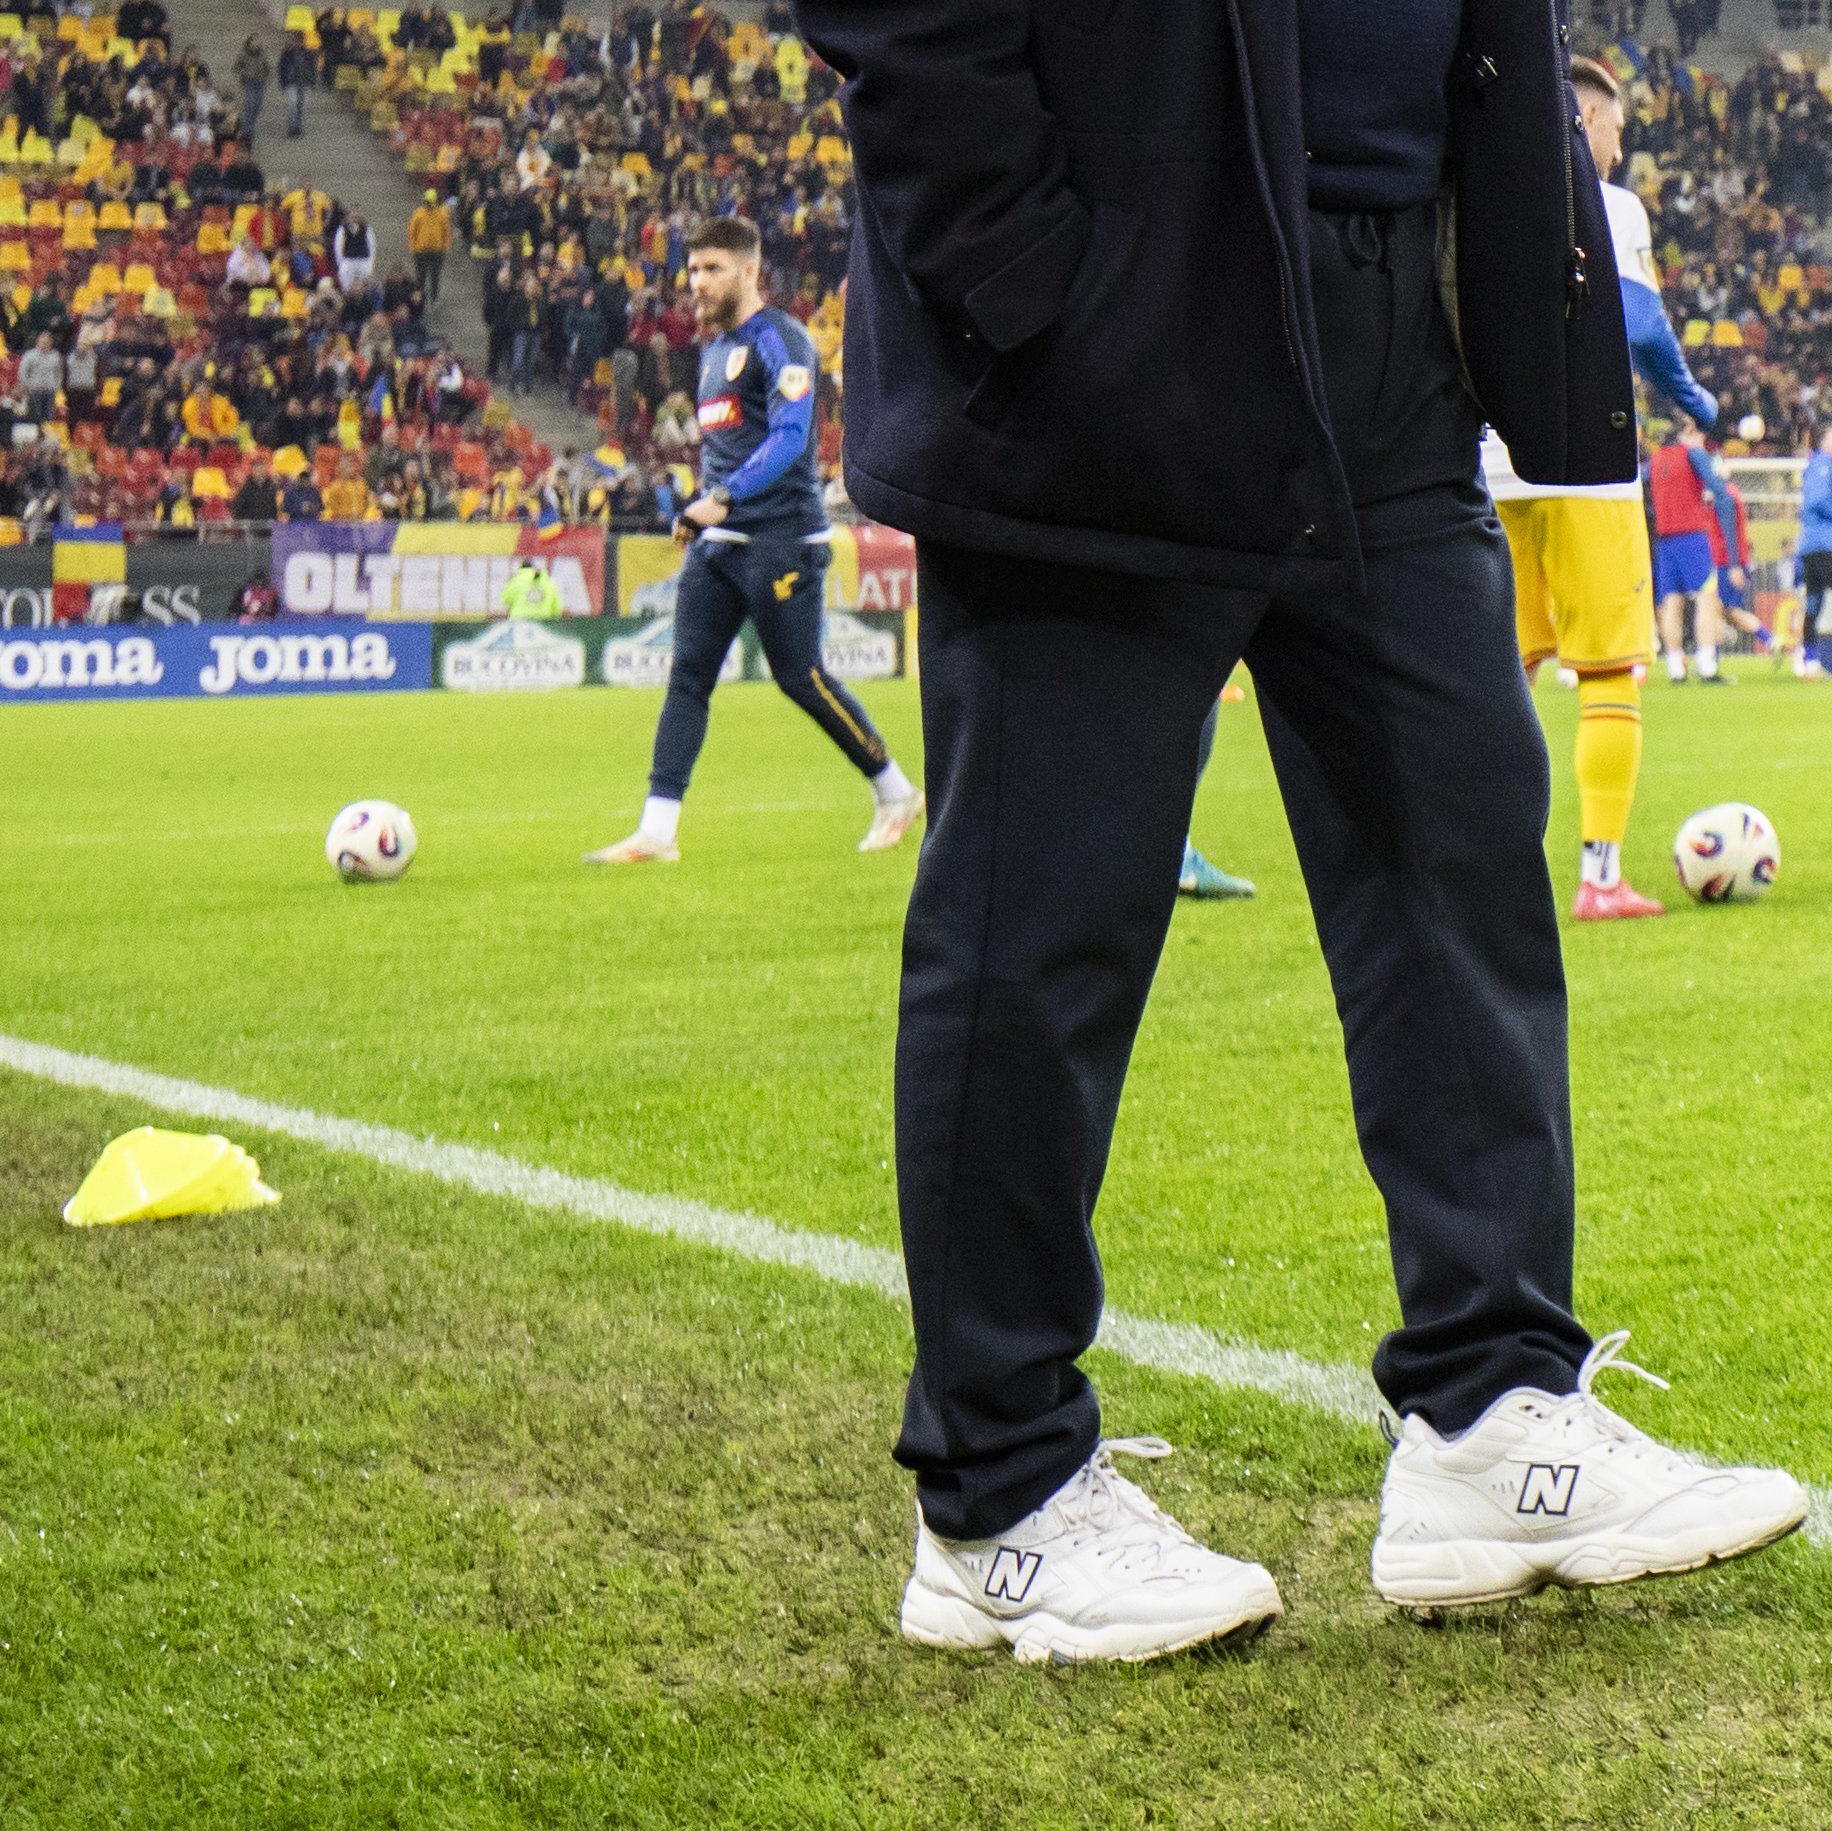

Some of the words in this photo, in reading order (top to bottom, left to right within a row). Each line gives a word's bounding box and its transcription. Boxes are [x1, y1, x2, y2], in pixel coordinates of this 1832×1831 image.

[0, 637, 164, 689] oma
[1517, 1463, 1580, 1517] N
[984, 1546, 1044, 1603] N
